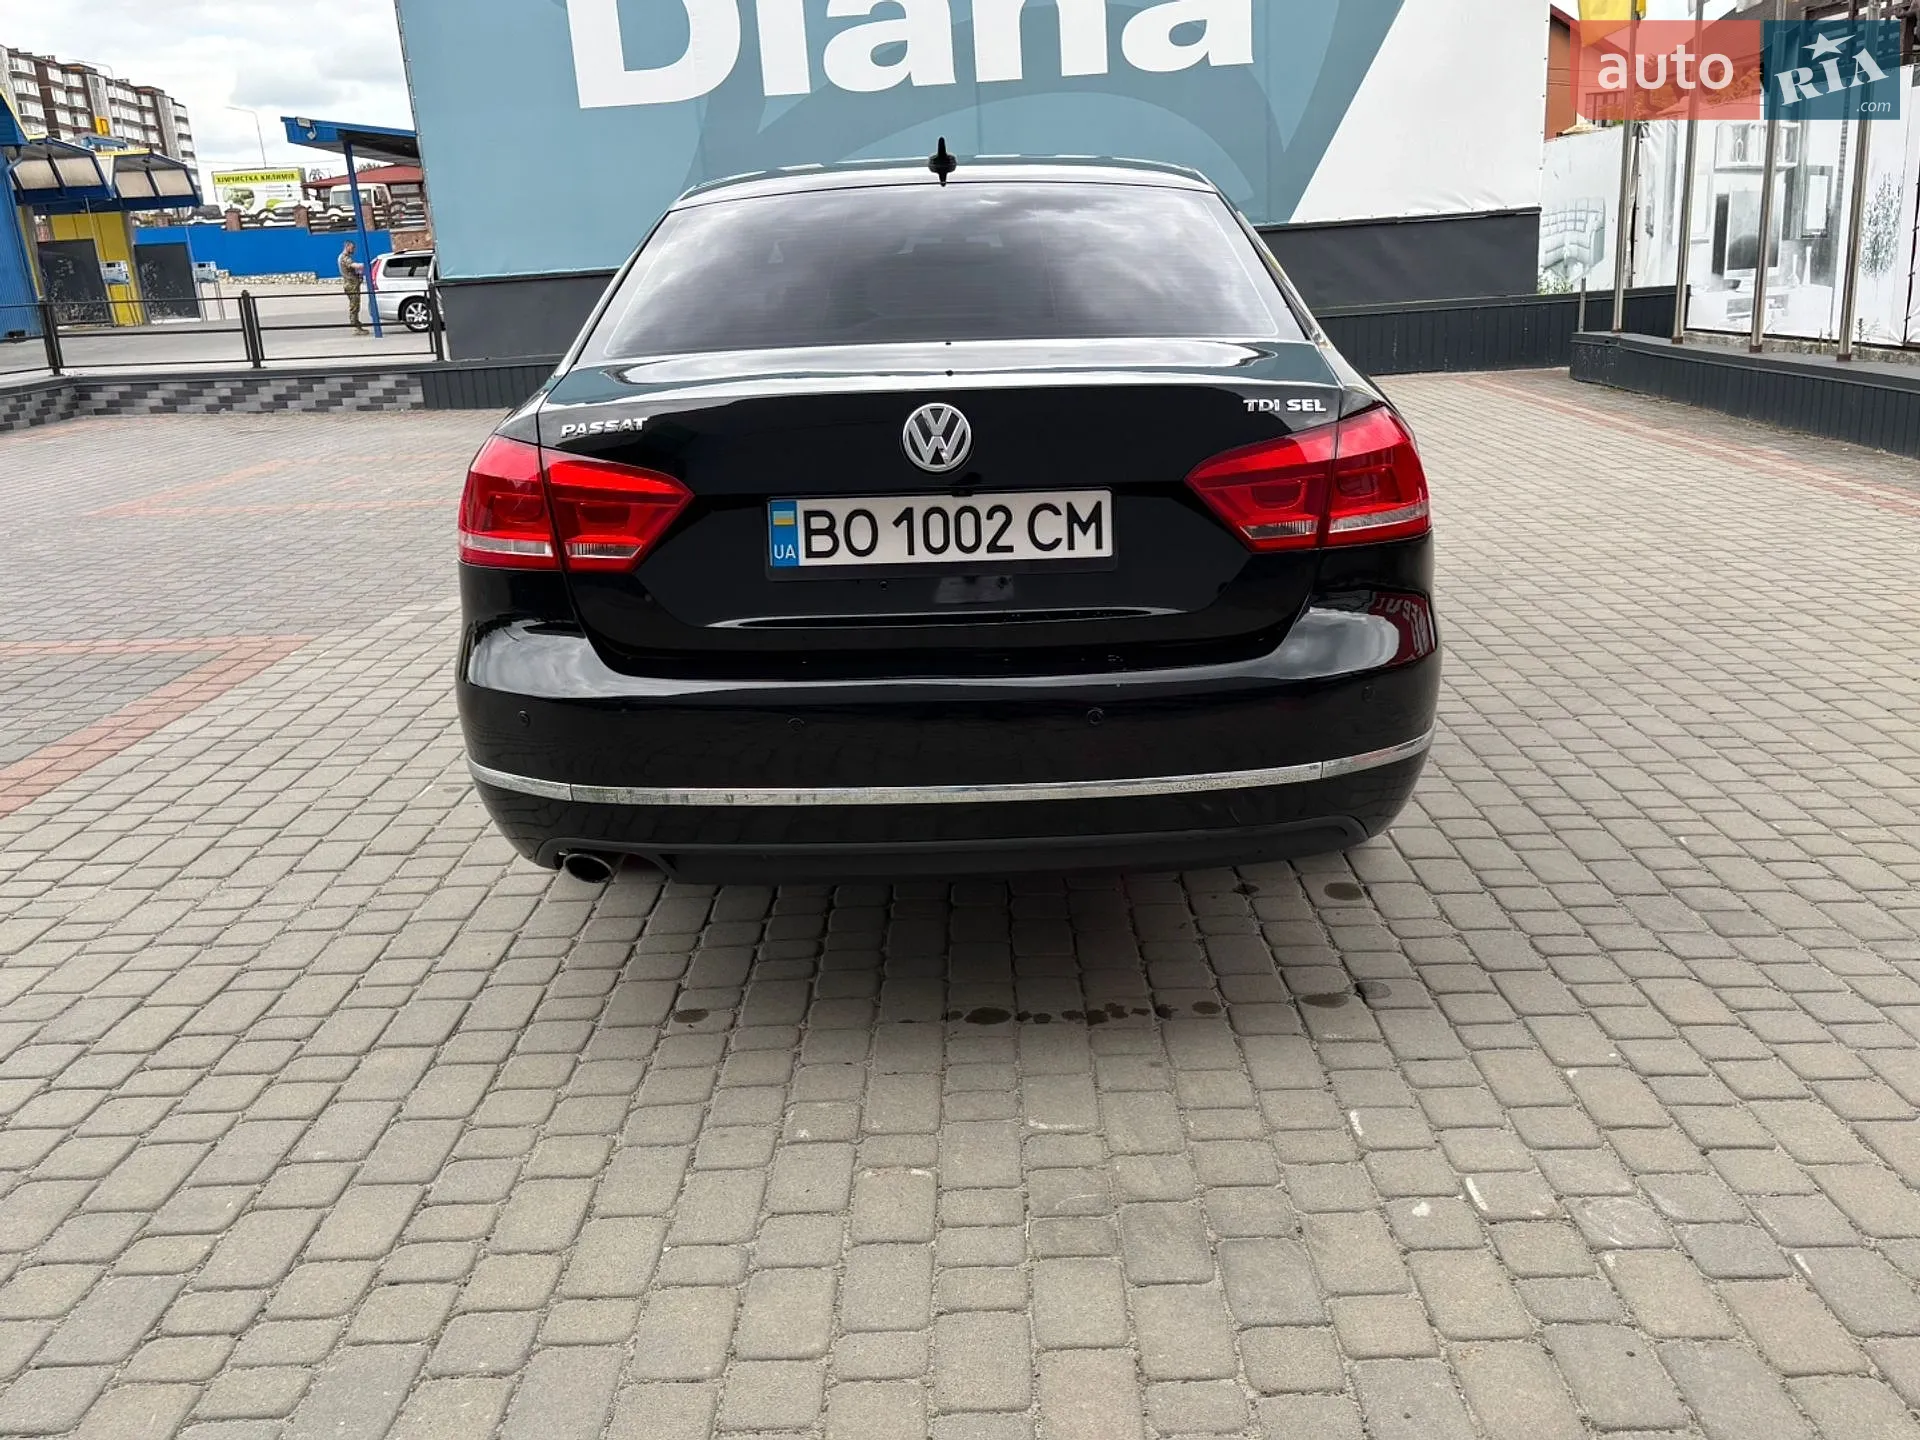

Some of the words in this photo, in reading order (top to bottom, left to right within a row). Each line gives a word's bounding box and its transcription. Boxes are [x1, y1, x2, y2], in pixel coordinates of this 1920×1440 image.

[1242, 399, 1280, 412] TDI
[1286, 399, 1327, 412] SEL
[561, 417, 648, 438] PASSAT
[803, 509, 879, 559] BO
[892, 504, 1014, 556] 1002
[1027, 500, 1103, 552] CM
[773, 543, 797, 561] UA
